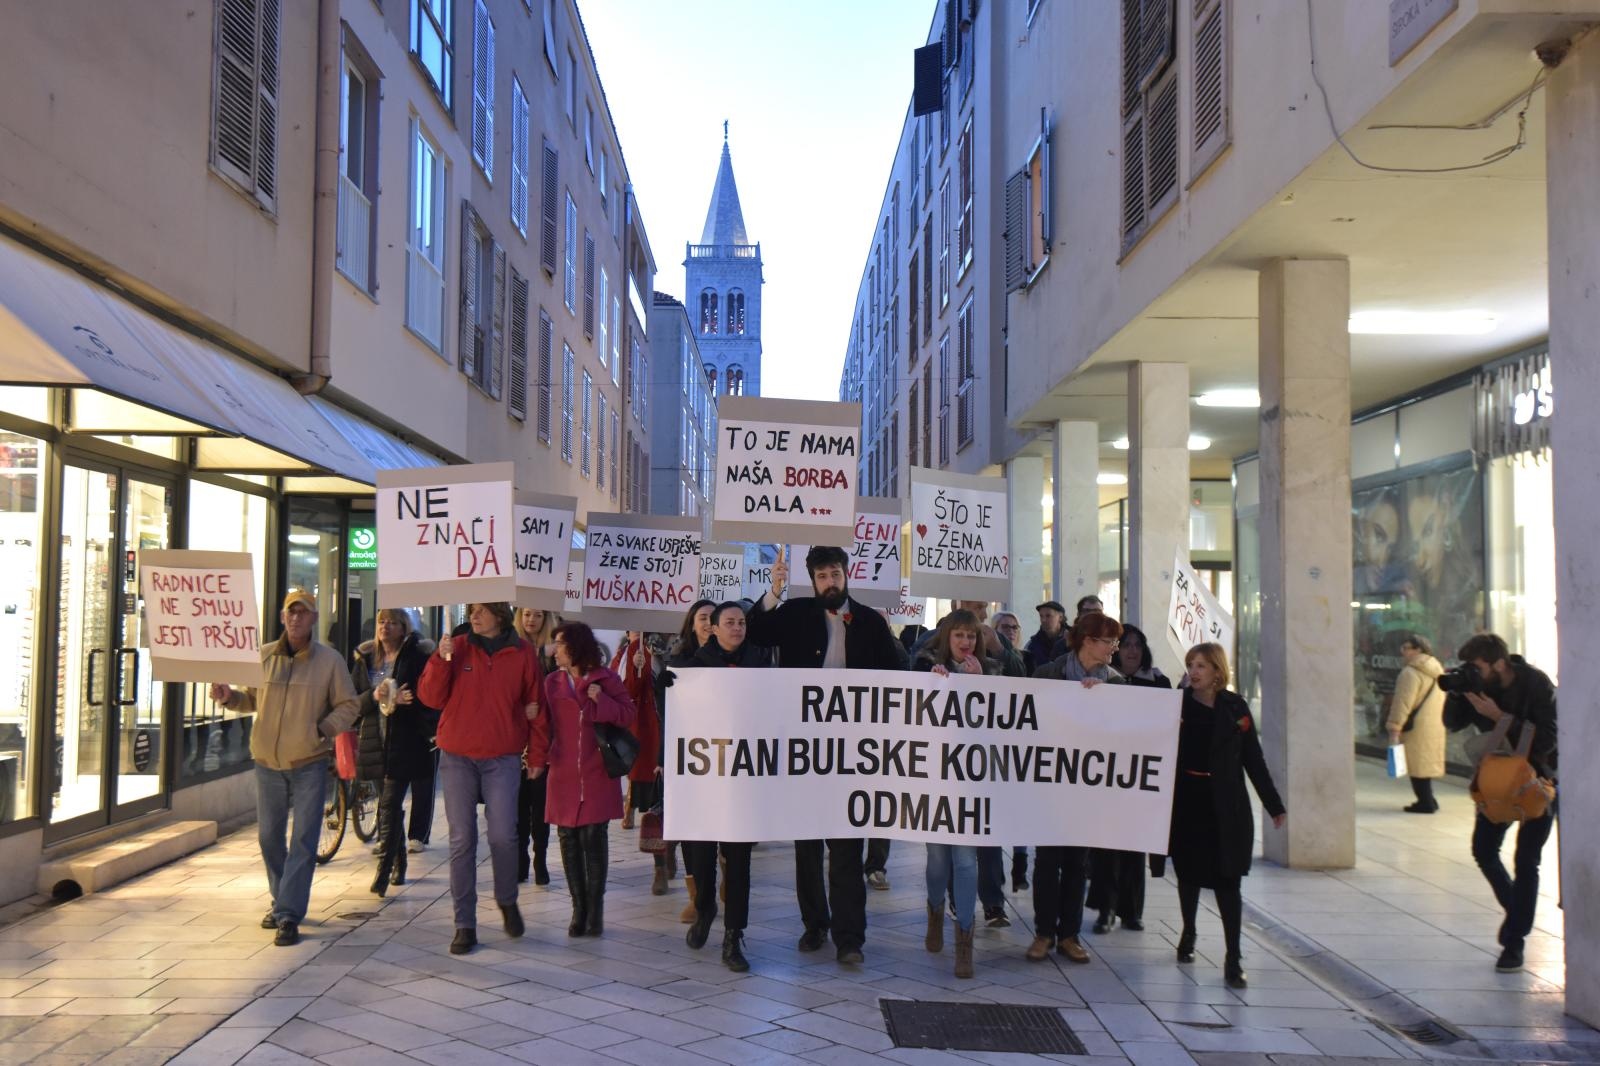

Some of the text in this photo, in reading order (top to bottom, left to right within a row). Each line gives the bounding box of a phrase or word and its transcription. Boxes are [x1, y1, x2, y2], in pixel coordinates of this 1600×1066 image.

[725, 426, 855, 457] TO JE NAMA
[726, 460, 849, 490] NAŠA BORBA
[397, 487, 449, 520] NE
[934, 489, 993, 528] ŠTO JE
[520, 516, 564, 539] SAM I
[937, 523, 984, 552] ŽENA
[589, 532, 701, 558] IZA SVAKE USPJEŠNE
[874, 543, 900, 561] ZA
[457, 545, 501, 578] DA
[599, 551, 684, 577] ŽENE STOJI
[917, 546, 1009, 575] BEZ BRKOVA?
[153, 572, 231, 593] RADNICE
[586, 574, 694, 605] MUŠKARAC
[713, 574, 740, 587] TREBA
[1176, 570, 1189, 597] ZA
[161, 598, 243, 617] NE SMIJU
[154, 621, 260, 652] JESTI PRŠUT!
[801, 685, 1039, 731] RATIFIKACIJA
[940, 742, 1163, 793] KONVENCIJE
[847, 789, 992, 836] ODMAH!
